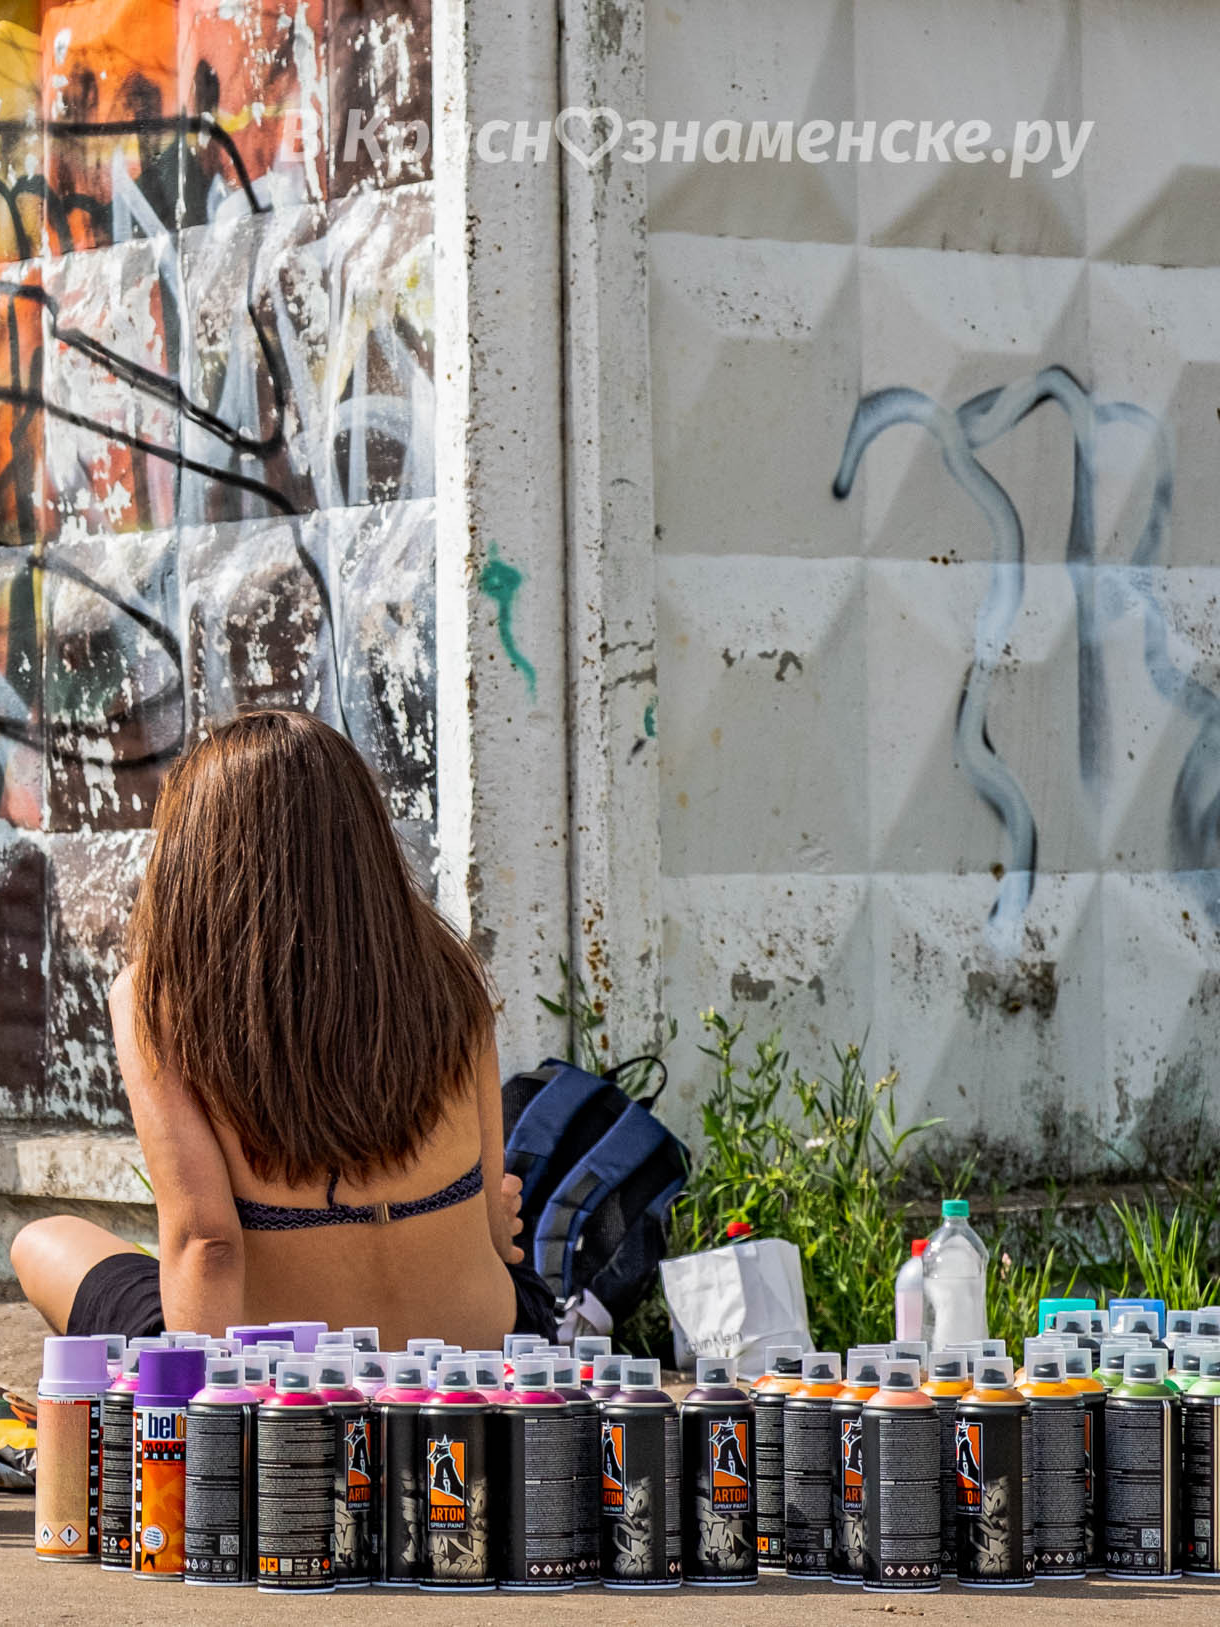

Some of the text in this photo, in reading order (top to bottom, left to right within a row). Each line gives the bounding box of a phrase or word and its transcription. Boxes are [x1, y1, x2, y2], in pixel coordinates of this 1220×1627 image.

[90, 1406, 100, 1536] PREMIUM
[714, 1487, 748, 1502] ARTON
[430, 1506, 466, 1521] ARTON
